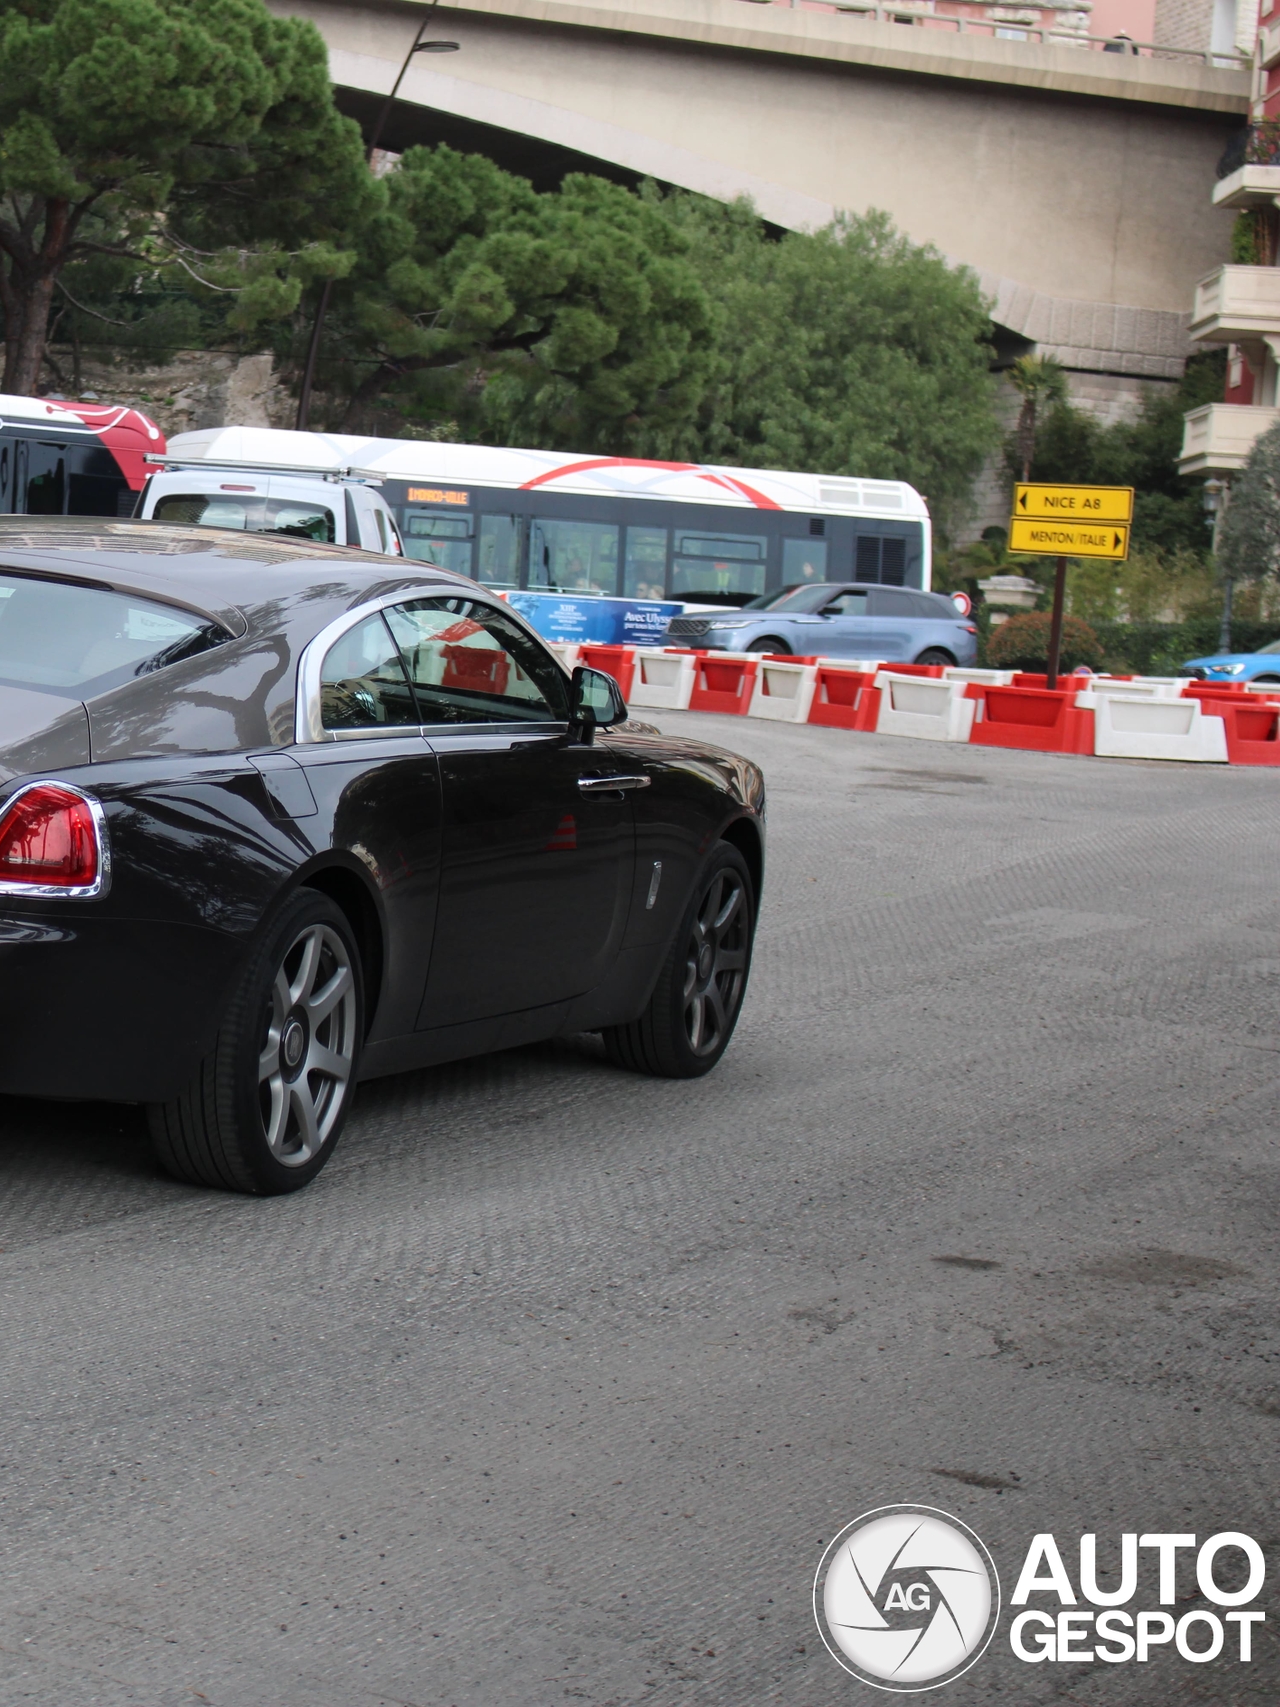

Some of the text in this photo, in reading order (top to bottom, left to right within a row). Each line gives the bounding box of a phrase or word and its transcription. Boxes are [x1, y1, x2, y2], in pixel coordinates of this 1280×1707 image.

[1044, 496, 1101, 510] NICE A8
[624, 611, 646, 622] Avec
